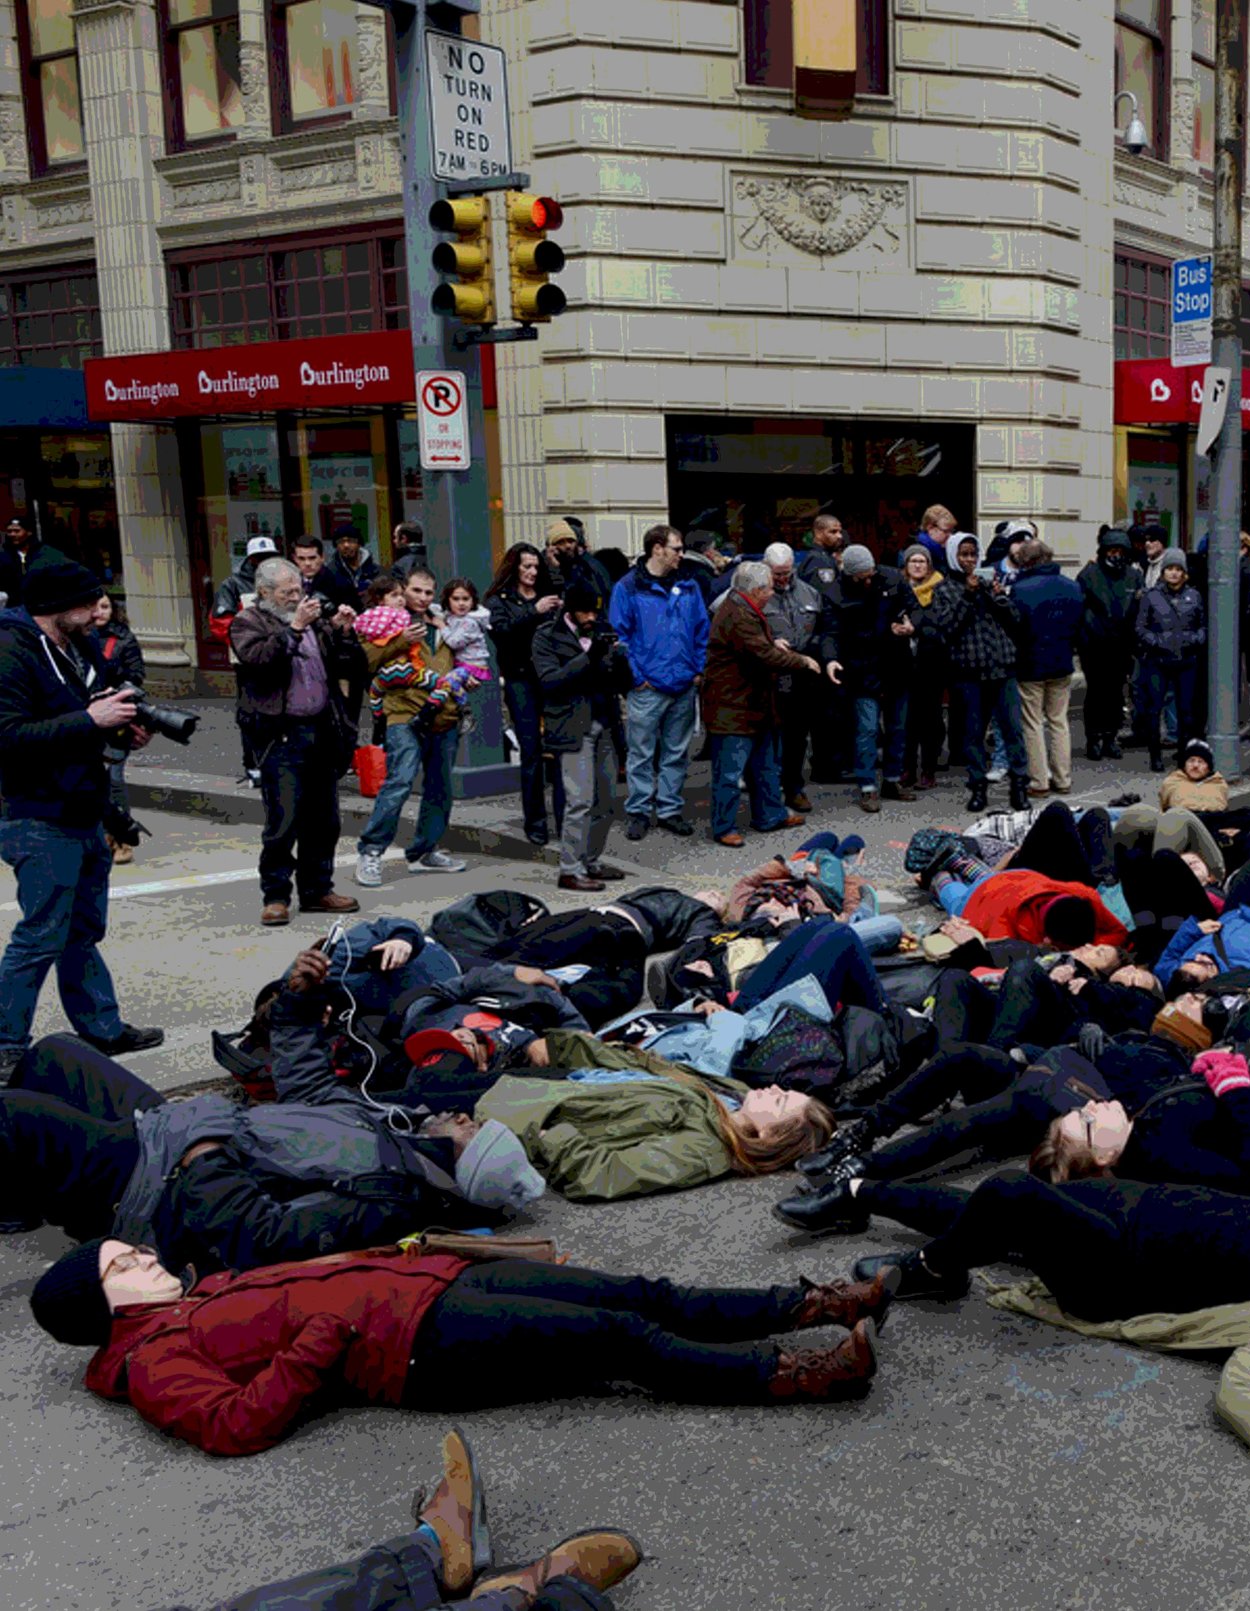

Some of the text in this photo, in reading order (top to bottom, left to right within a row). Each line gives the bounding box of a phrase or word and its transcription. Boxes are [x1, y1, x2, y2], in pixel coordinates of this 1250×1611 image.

[448, 46, 485, 75] NO
[443, 74, 493, 102] TURN
[457, 104, 482, 126] ON
[454, 129, 489, 152] RED
[1178, 266, 1207, 287] Bus
[1175, 292, 1209, 313] Stop
[105, 361, 390, 405] Burlington Burlington Burlington
[438, 423, 450, 433] OR
[427, 439, 462, 449] STOPPING
